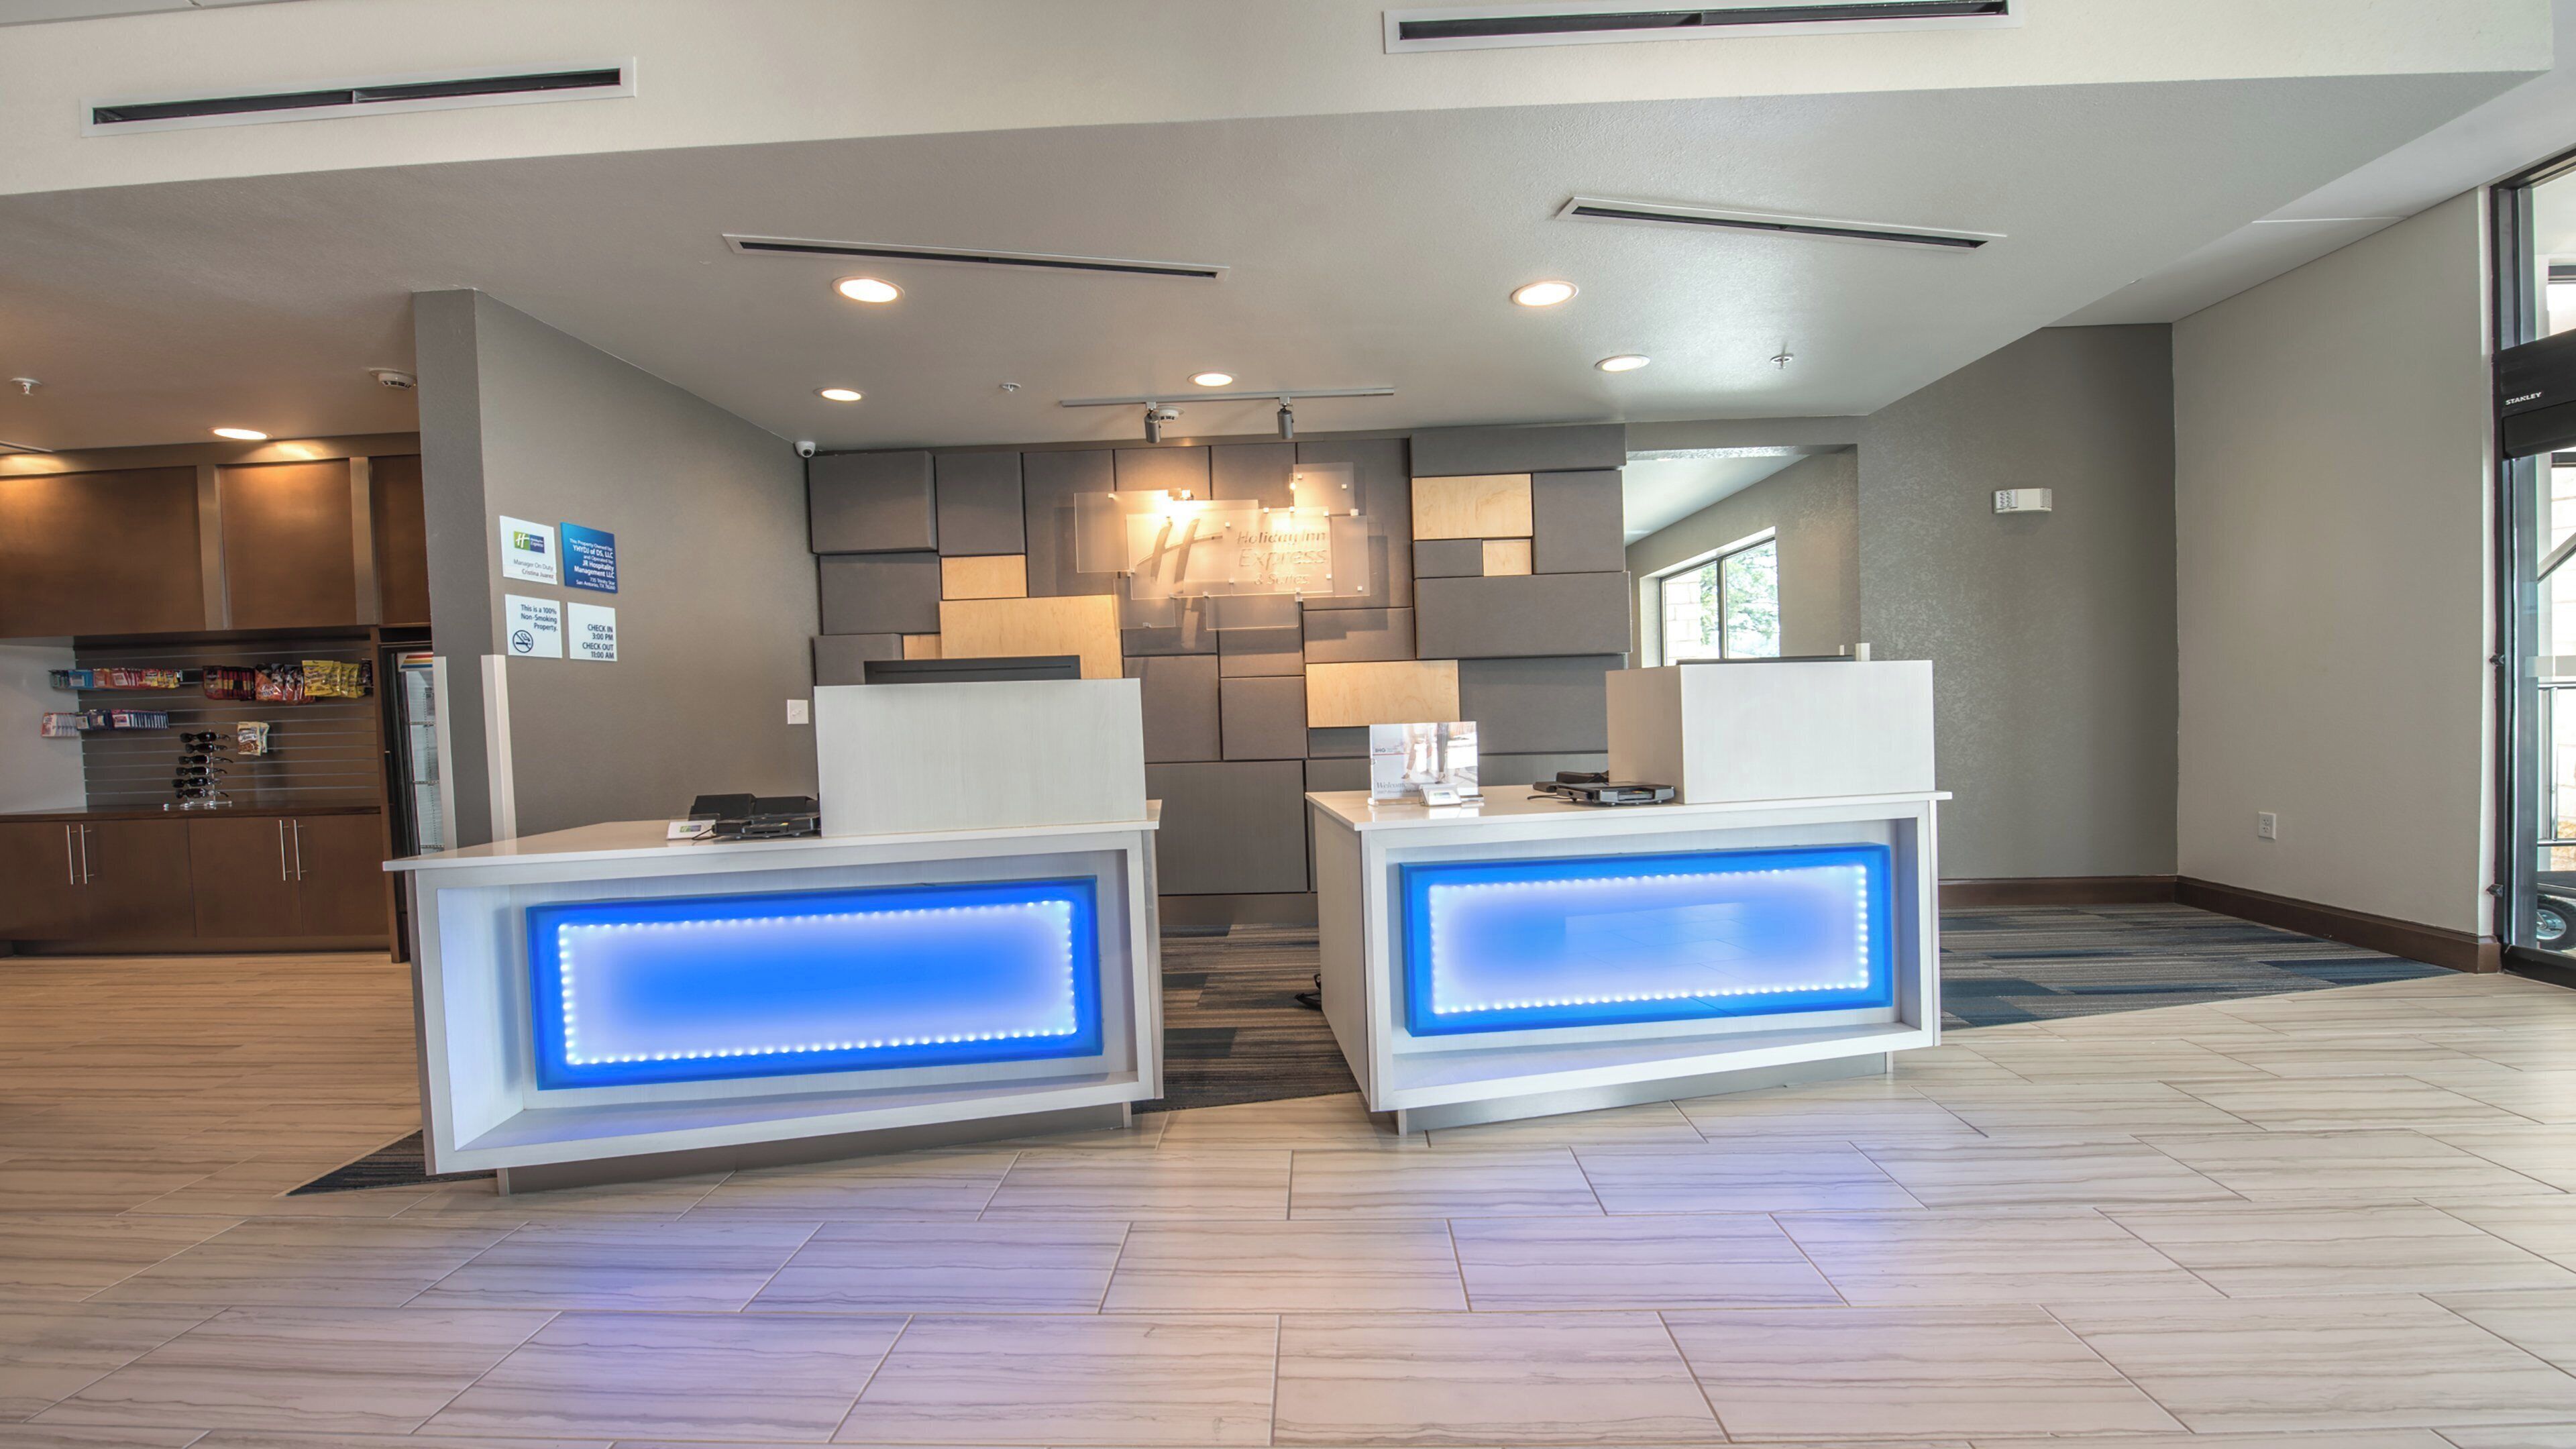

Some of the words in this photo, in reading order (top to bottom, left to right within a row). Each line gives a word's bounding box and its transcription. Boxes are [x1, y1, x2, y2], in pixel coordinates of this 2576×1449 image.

[2505, 392, 2542, 406] STANLEY
[1238, 531, 1298, 545] Holiday
[1301, 530, 1326, 541] Inn
[578, 540, 594, 548] Property
[604, 551, 614, 559] LLC
[1239, 549, 1328, 570] Express
[513, 558, 534, 569] Manager
[542, 564, 553, 572] Duty
[589, 561, 614, 572] Hospitality
[521, 568, 539, 577] Cristina
[574, 566, 606, 576] Management
[1253, 572, 1263, 585] &
[1267, 572, 1310, 585] Suites
[521, 604, 533, 612] This
[543, 606, 557, 614] 100%
[521, 612, 557, 625] Non-Smoking
[534, 622, 558, 632] Property.
[587, 624, 606, 633] CHECK
[582, 642, 602, 650] CHECK
